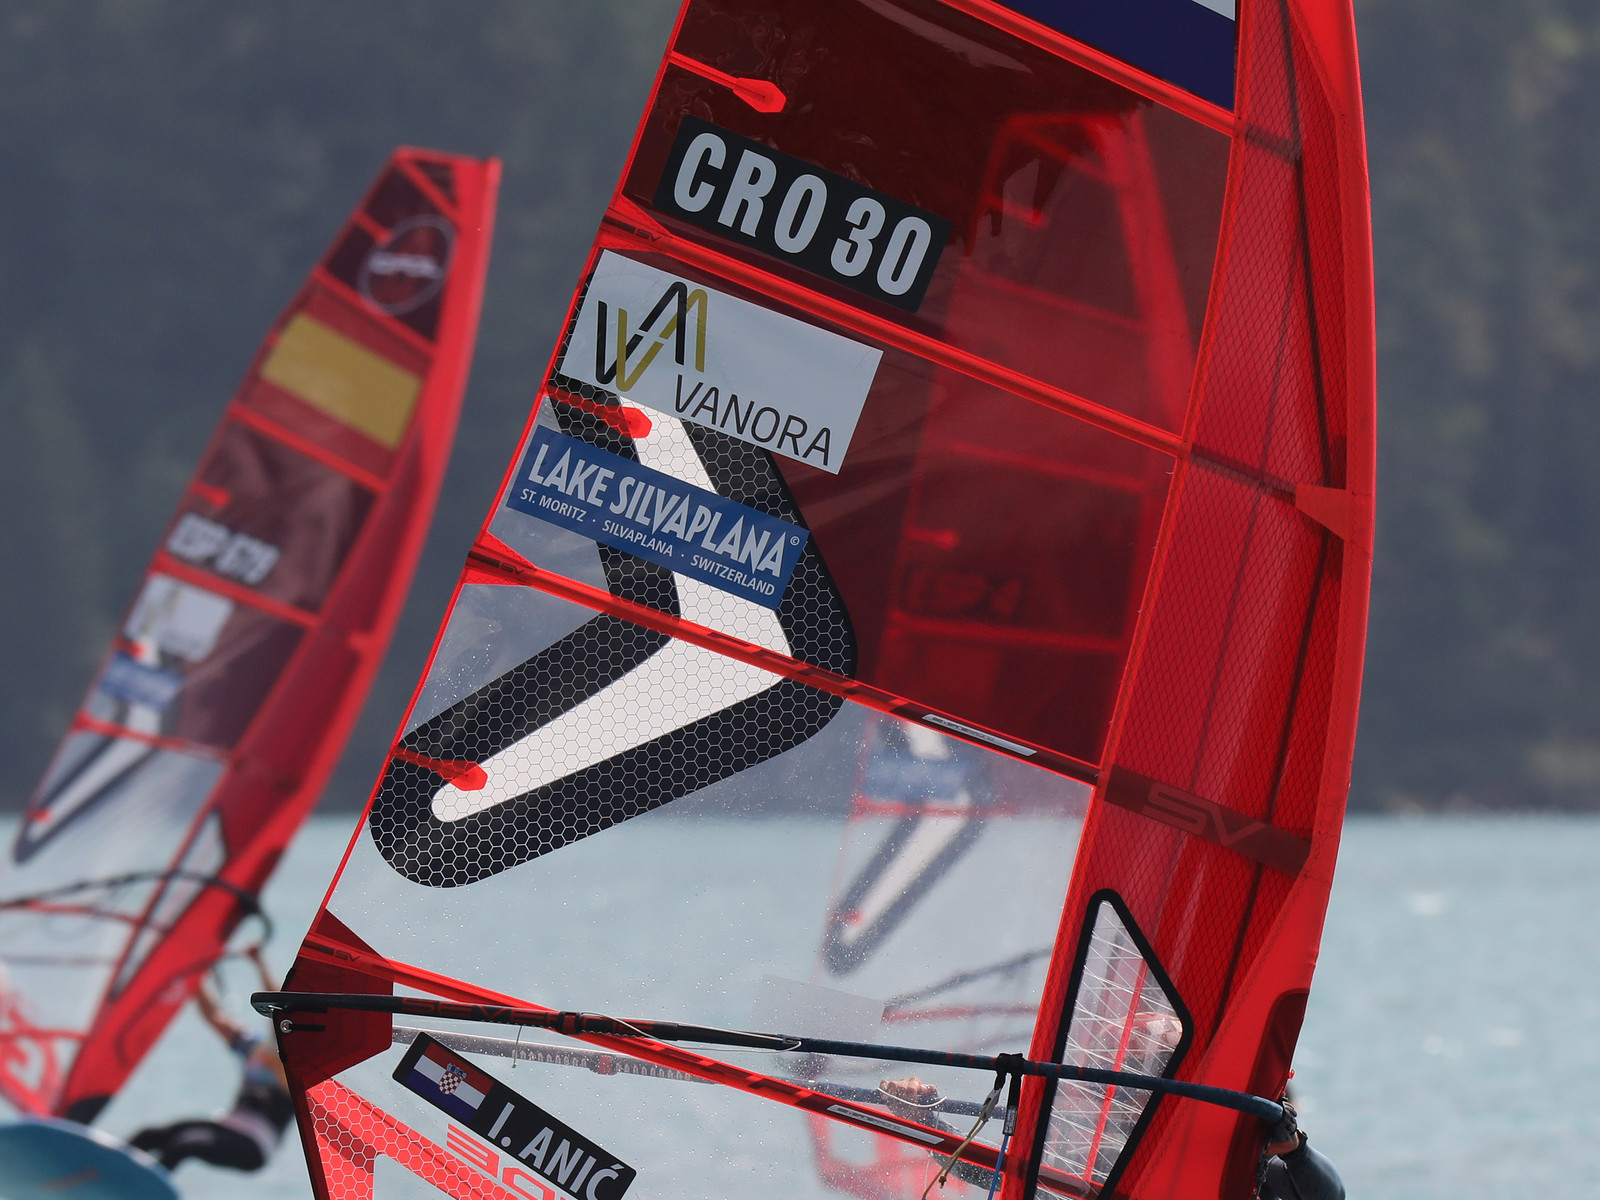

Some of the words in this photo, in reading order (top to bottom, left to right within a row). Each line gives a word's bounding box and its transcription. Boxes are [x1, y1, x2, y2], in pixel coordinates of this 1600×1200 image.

[673, 132, 828, 254] CRO
[830, 197, 932, 296] 30
[675, 374, 832, 466] VANORA
[520, 488, 536, 504] ST.
[538, 496, 588, 523] MORITZ
[602, 519, 674, 557] SILVAPLANA
[690, 554, 776, 597] SWITZERLAND
[528, 443, 615, 507] LAKE
[609, 475, 787, 578] SILVAPLANA
[402, 998, 656, 1036] SEVENE
[487, 1102, 516, 1148] I.
